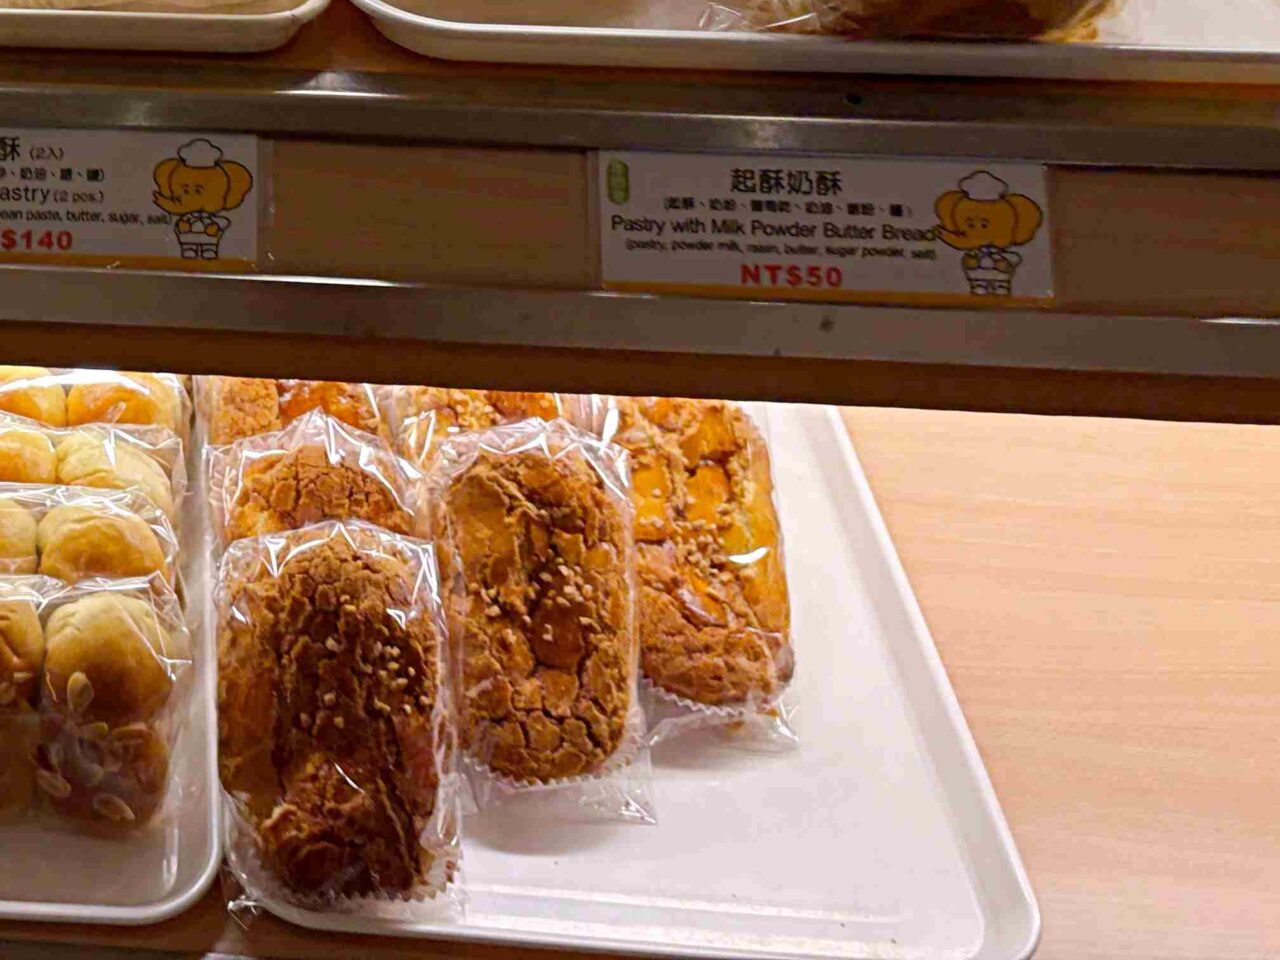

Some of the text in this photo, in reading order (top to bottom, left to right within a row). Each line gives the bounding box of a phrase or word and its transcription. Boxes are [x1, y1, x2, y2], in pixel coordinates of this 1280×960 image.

[731, 168, 842, 196] 起酥奶酥
[66, 210, 105, 224] butter,
[611, 214, 937, 242] Pastry with Milk Powder Butter Bread
[740, 263, 843, 288] NT$50
